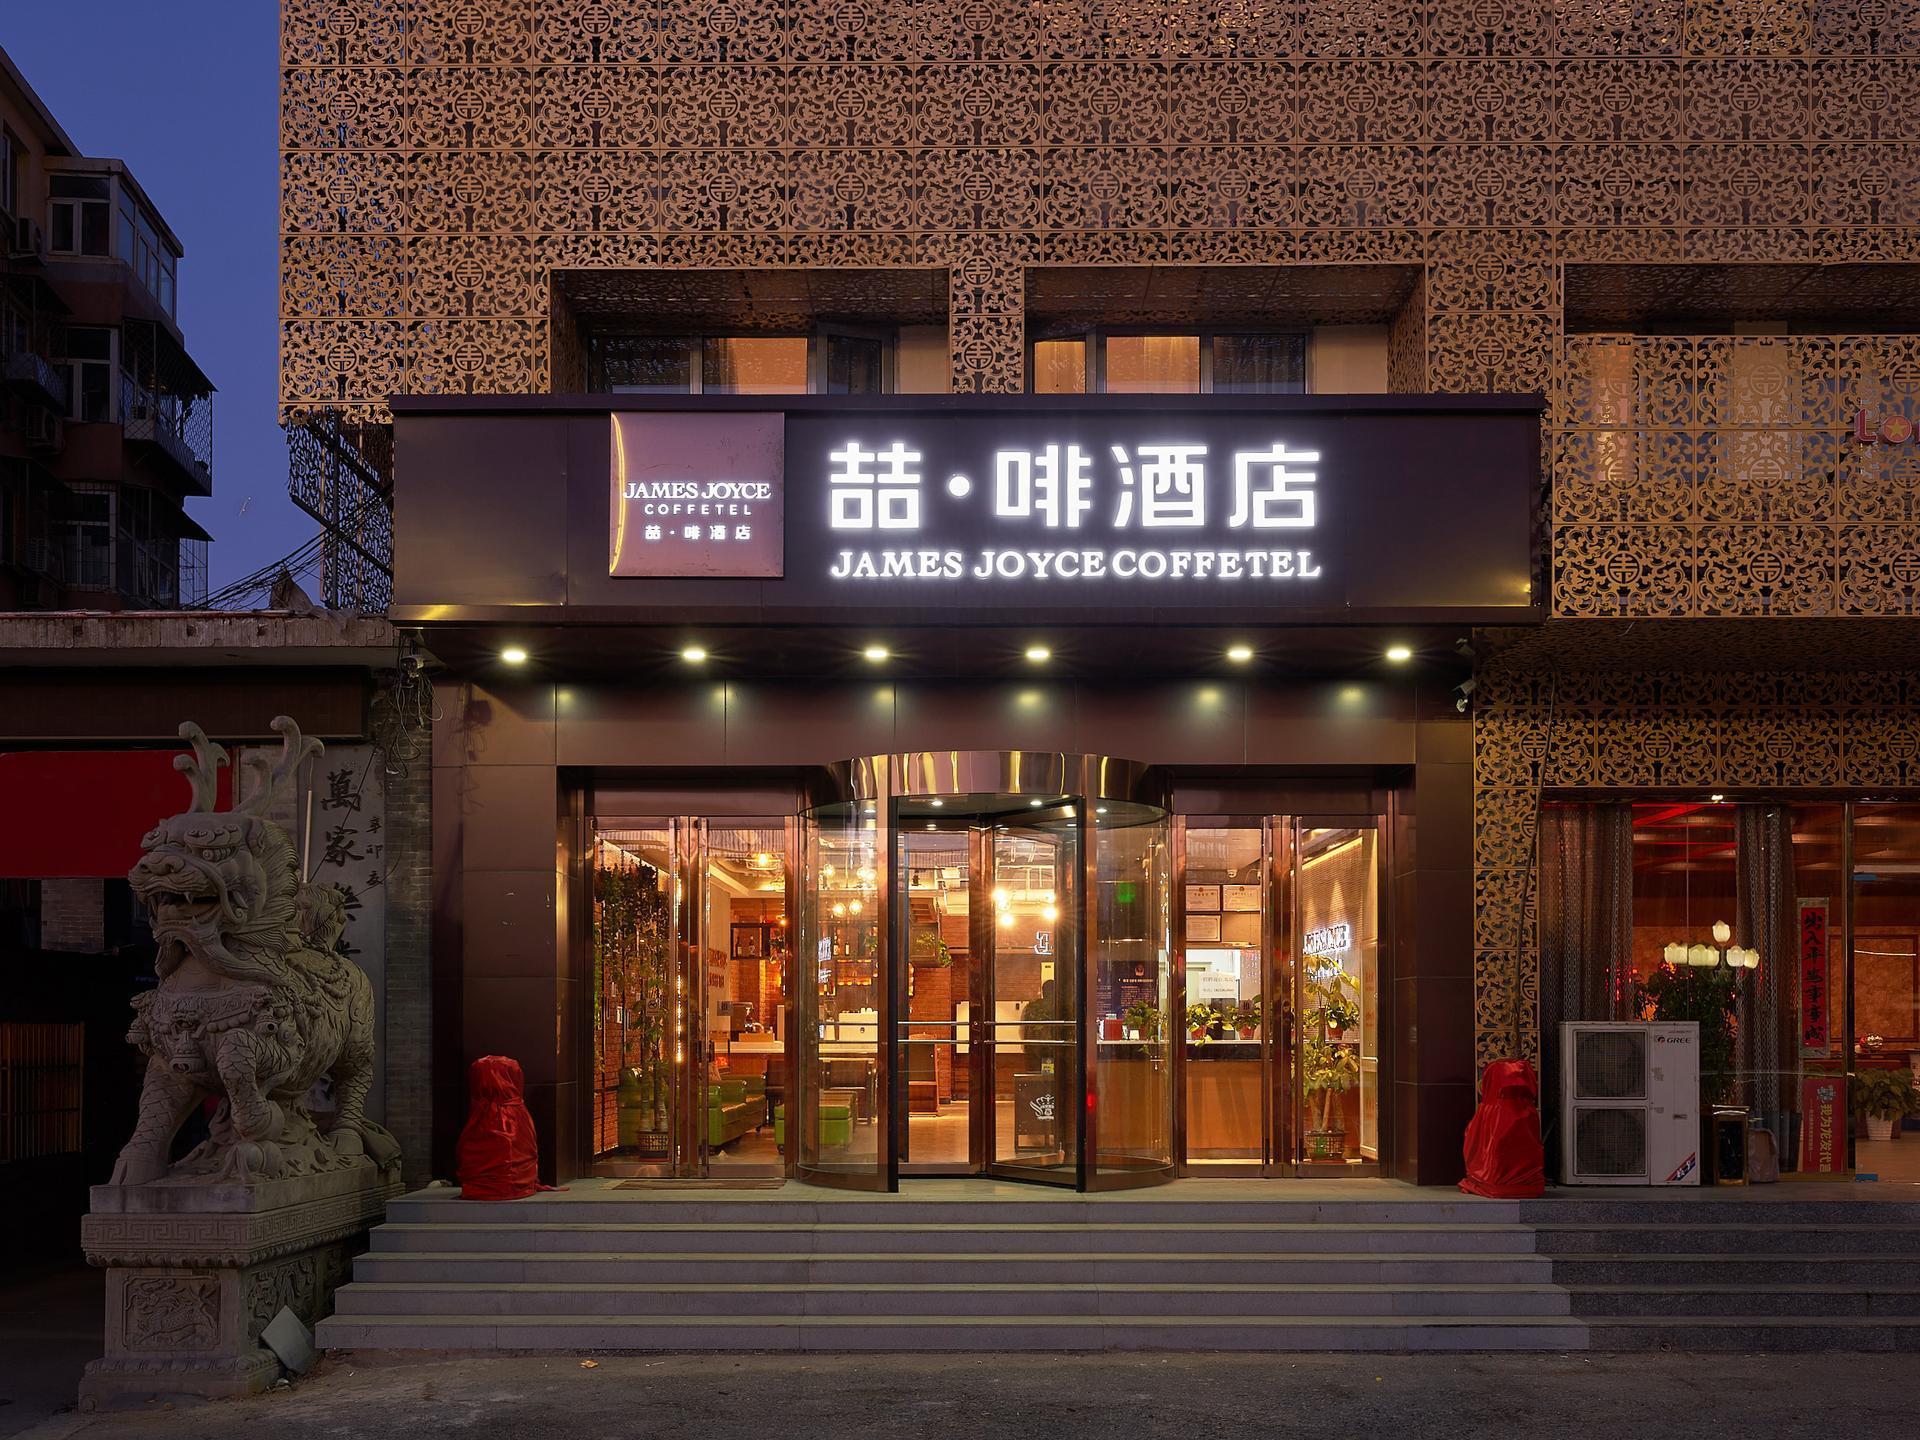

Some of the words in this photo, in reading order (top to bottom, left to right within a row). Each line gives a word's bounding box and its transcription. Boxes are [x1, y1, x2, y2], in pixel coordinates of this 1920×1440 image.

[623, 482, 699, 499] JAMES
[701, 482, 772, 499] JOYCE
[644, 503, 752, 516] COFFETEL
[831, 551, 963, 578] JAMES
[973, 551, 1106, 578] JOYCE
[1111, 551, 1321, 578] COFFETEL
